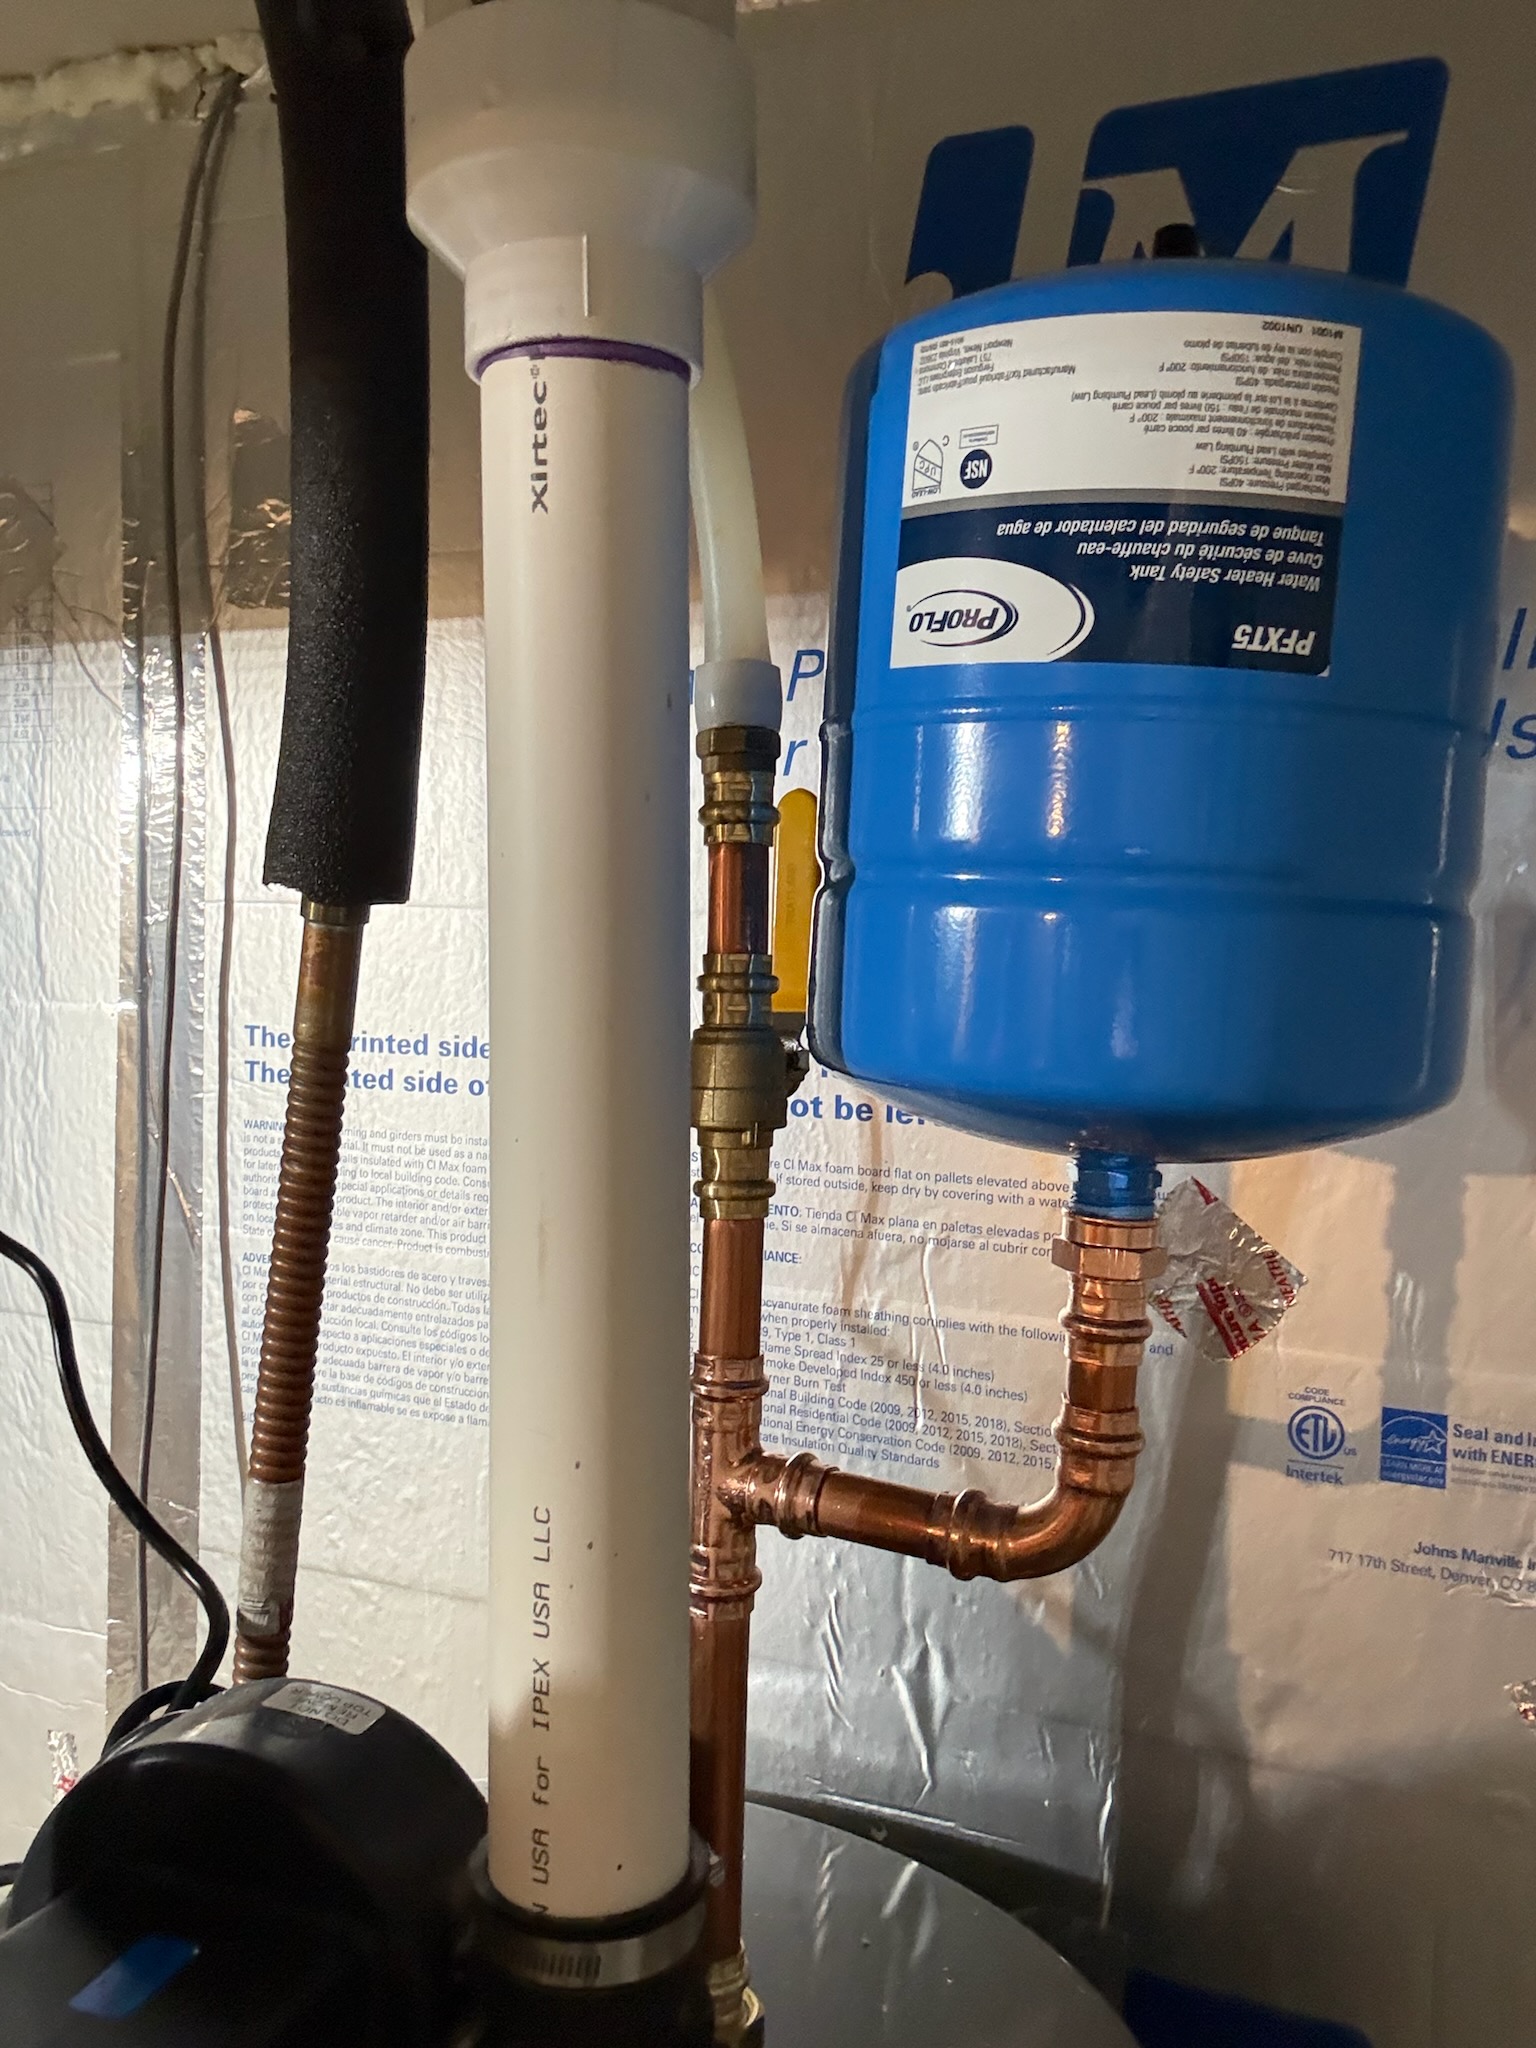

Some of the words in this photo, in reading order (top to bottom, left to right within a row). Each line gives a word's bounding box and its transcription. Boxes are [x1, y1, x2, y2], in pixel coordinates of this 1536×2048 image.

[1023, 365, 1076, 378] Manufactured
[1093, 389, 1131, 400] Plumbing
[919, 460, 936, 476] UPC
[963, 459, 988, 480] NSF
[997, 519, 1031, 536] agua
[1034, 521, 1052, 536] de
[1055, 520, 1137, 535] calentador
[1140, 520, 1165, 535] del
[1167, 519, 1247, 537] seguridad
[1250, 525, 1270, 540] de
[1273, 525, 1324, 546] Tanque
[1077, 541, 1171, 558] chauffe-eau
[1174, 543, 1195, 559] du
[1199, 544, 1262, 563] sécurité
[1265, 549, 1284, 565] de
[1287, 553, 1323, 569] Cuve
[1129, 565, 1166, 580] Tank
[1170, 563, 1221, 583] Safety
[1223, 569, 1276, 588] Heater
[1278, 574, 1320, 592] Water
[1231, 624, 1316, 656] PFXT5
[244, 1025, 290, 1048] The
[439, 1035, 489, 1058] side
[244, 1060, 290, 1083] The
[403, 1070, 458, 1094] side
[789, 1095, 822, 1120] ot
[835, 1095, 873, 1122] be
[370, 1129, 386, 1139] and
[390, 1131, 421, 1142] girders
[425, 1134, 447, 1143] must
[451, 1134, 462, 1144] be
[361, 1155, 401, 1168] insulated
[439, 1161, 459, 1172] Max
[462, 1162, 486, 1174] foam
[797, 1160, 821, 1172] Max
[825, 1162, 853, 1175] foam
[857, 1164, 890, 1178] board
[894, 1168, 911, 1180] flat
[915, 1171, 930, 1181] on
[934, 1172, 972, 1185] pallets
[976, 1175, 1027, 1189] elevated
[1031, 1179, 1069, 1192] above
[786, 1176, 820, 1187] stored
[823, 1179, 867, 1193] outside,
[871, 1181, 898, 1195] keep
[902, 1184, 920, 1198] dry
[924, 1187, 938, 1199] by
[942, 1189, 993, 1205] covering
[998, 1193, 1023, 1204] with
[1028, 1198, 1035, 1206] a
[376, 1196, 392, 1207] The
[346, 1222, 362, 1232] and
[428, 1228, 447, 1239] This
[450, 1232, 486, 1244] product
[805, 1207, 842, 1221] Tienda
[860, 1212, 884, 1225] Max
[888, 1215, 919, 1228] plana
[922, 1220, 936, 1229] en
[940, 1221, 982, 1234] paletas
[986, 1224, 1039, 1239] elevadas
[791, 1316, 837, 1332] properly
[822, 1303, 851, 1317] foam
[968, 1321, 994, 1333] with
[998, 1324, 1017, 1336] the
[774, 1327, 801, 1342] Type
[805, 1331, 814, 1344] 1,
[817, 1332, 846, 1346] Class
[850, 1336, 855, 1347] 1
[1148, 1343, 1173, 1356] and
[794, 1344, 833, 1360] Spread
[836, 1350, 867, 1365] Index
[870, 1355, 884, 1367] 25
[887, 1359, 898, 1370] or
[902, 1359, 924, 1372] less
[928, 1362, 949, 1375] (4.0
[952, 1366, 994, 1381] inches)
[766, 1358, 795, 1371] moke
[798, 1361, 856, 1378] Developed
[860, 1369, 891, 1383] Index
[894, 1375, 914, 1387] 450
[919, 1379, 930, 1388] or
[934, 1379, 956, 1392] less
[960, 1384, 981, 1396] (4.0
[985, 1387, 1027, 1402] inches)
[794, 1375, 819, 1389] Burn
[824, 1379, 846, 1393] Test
[1288, 1392, 1345, 1406] COMPLIANCE
[1305, 1386, 1330, 1396] CODE
[790, 1390, 834, 1408] Building
[838, 1397, 866, 1411] Code
[870, 1401, 903, 1417] (2009,
[907, 1407, 937, 1422] 2012,
[941, 1411, 971, 1427] 2015,
[975, 1415, 1010, 1432] 2018),
[1295, 1413, 1337, 1452] ETL
[1453, 1424, 1488, 1441] Seal
[1494, 1432, 1523, 1446] and
[782, 1434, 834, 1452] Insulation
[838, 1442, 878, 1461] Quality
[881, 1449, 940, 1468] Standards
[796, 1422, 834, 1439] Energy
[838, 1427, 911, 1448] Conservation
[915, 1439, 945, 1453] Code
[949, 1443, 983, 1460] (2009,
[988, 1450, 1019, 1465] 2012,
[1023, 1455, 1055, 1471] 2015,
[1453, 1447, 1487, 1462] with
[1286, 1464, 1343, 1485] Intertek
[534, 1505, 551, 1563] LLC
[1414, 1542, 1457, 1559] Johns
[1462, 1548, 1523, 1568] Manville
[1328, 1549, 1352, 1563] 717
[1358, 1554, 1386, 1570] 17th
[1391, 1559, 1435, 1579] Street,
[1500, 1575, 1522, 1591] CO
[533, 1582, 550, 1637] USA
[533, 1658, 550, 1731] IPEX
[533, 1756, 551, 1805] for
[533, 1829, 549, 1884] USA
